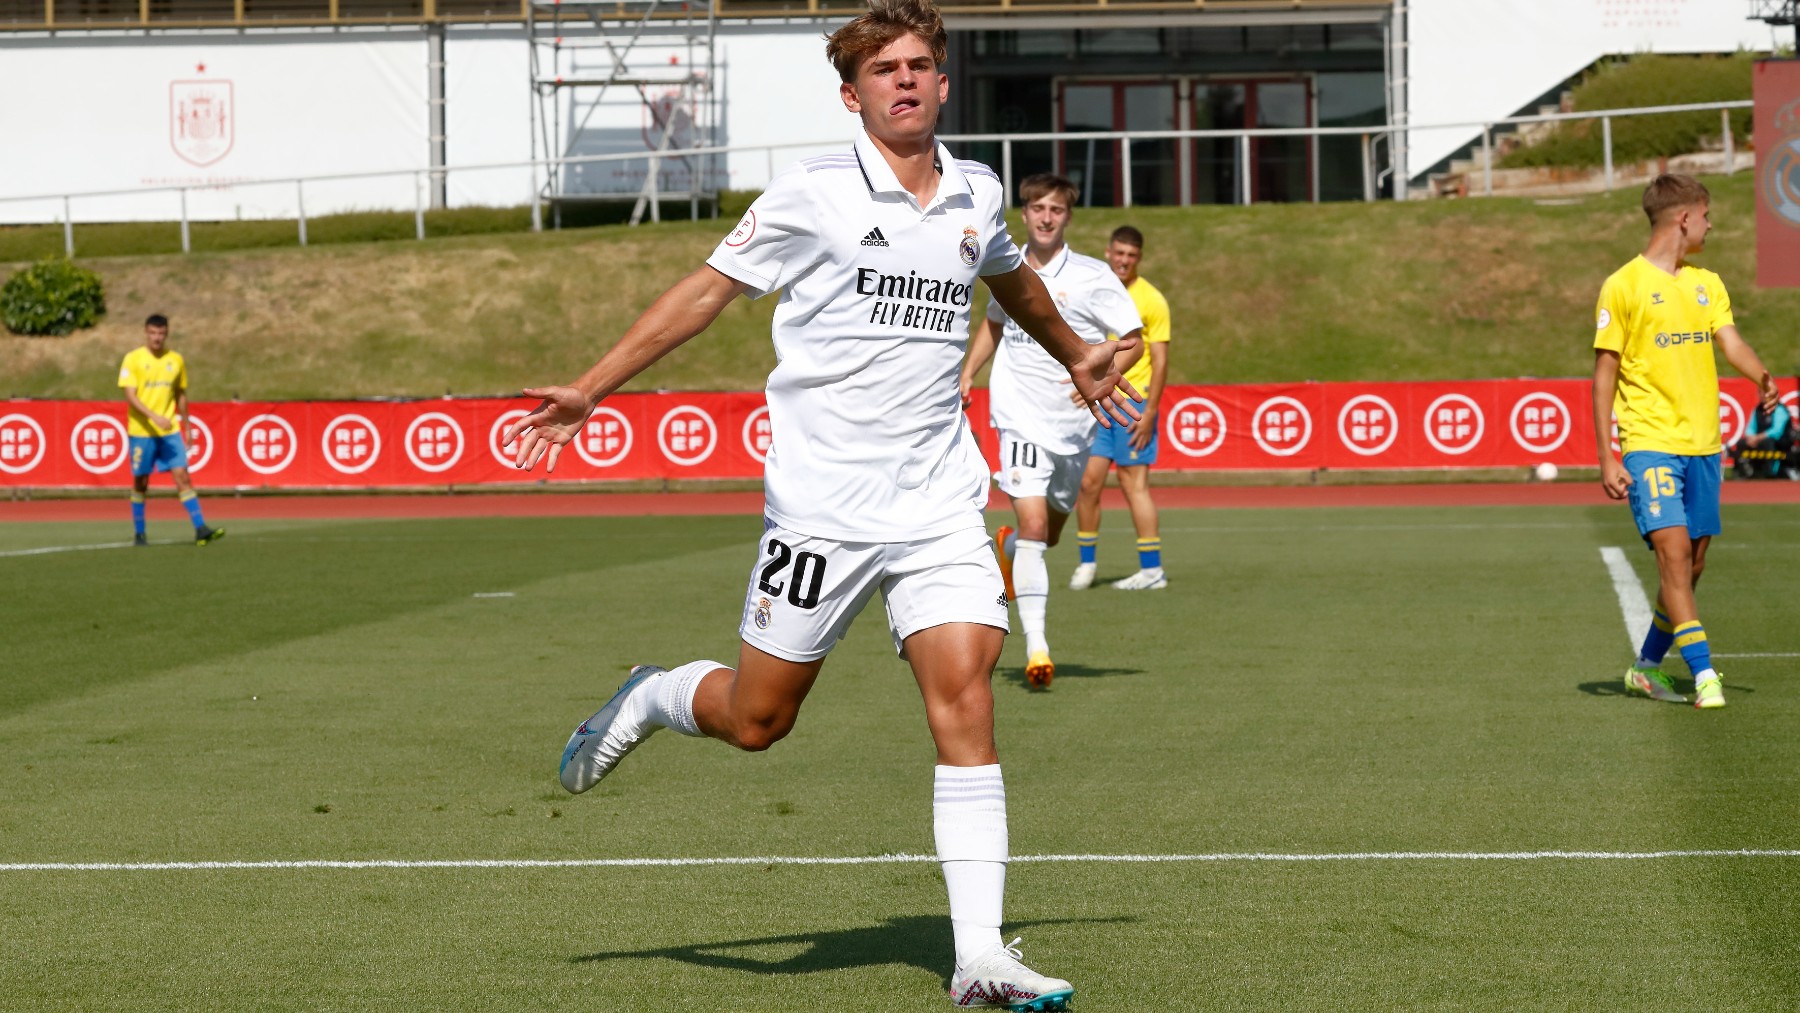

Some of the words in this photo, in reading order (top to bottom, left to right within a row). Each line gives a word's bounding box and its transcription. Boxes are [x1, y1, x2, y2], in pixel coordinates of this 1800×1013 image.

[860, 239, 890, 247] adidas
[856, 267, 972, 307] Emirates
[869, 301, 901, 326] FLY
[902, 304, 956, 333] BETTER
[1010, 441, 1037, 469] 10
[1643, 466, 1676, 499] 15
[758, 538, 827, 610] 20
